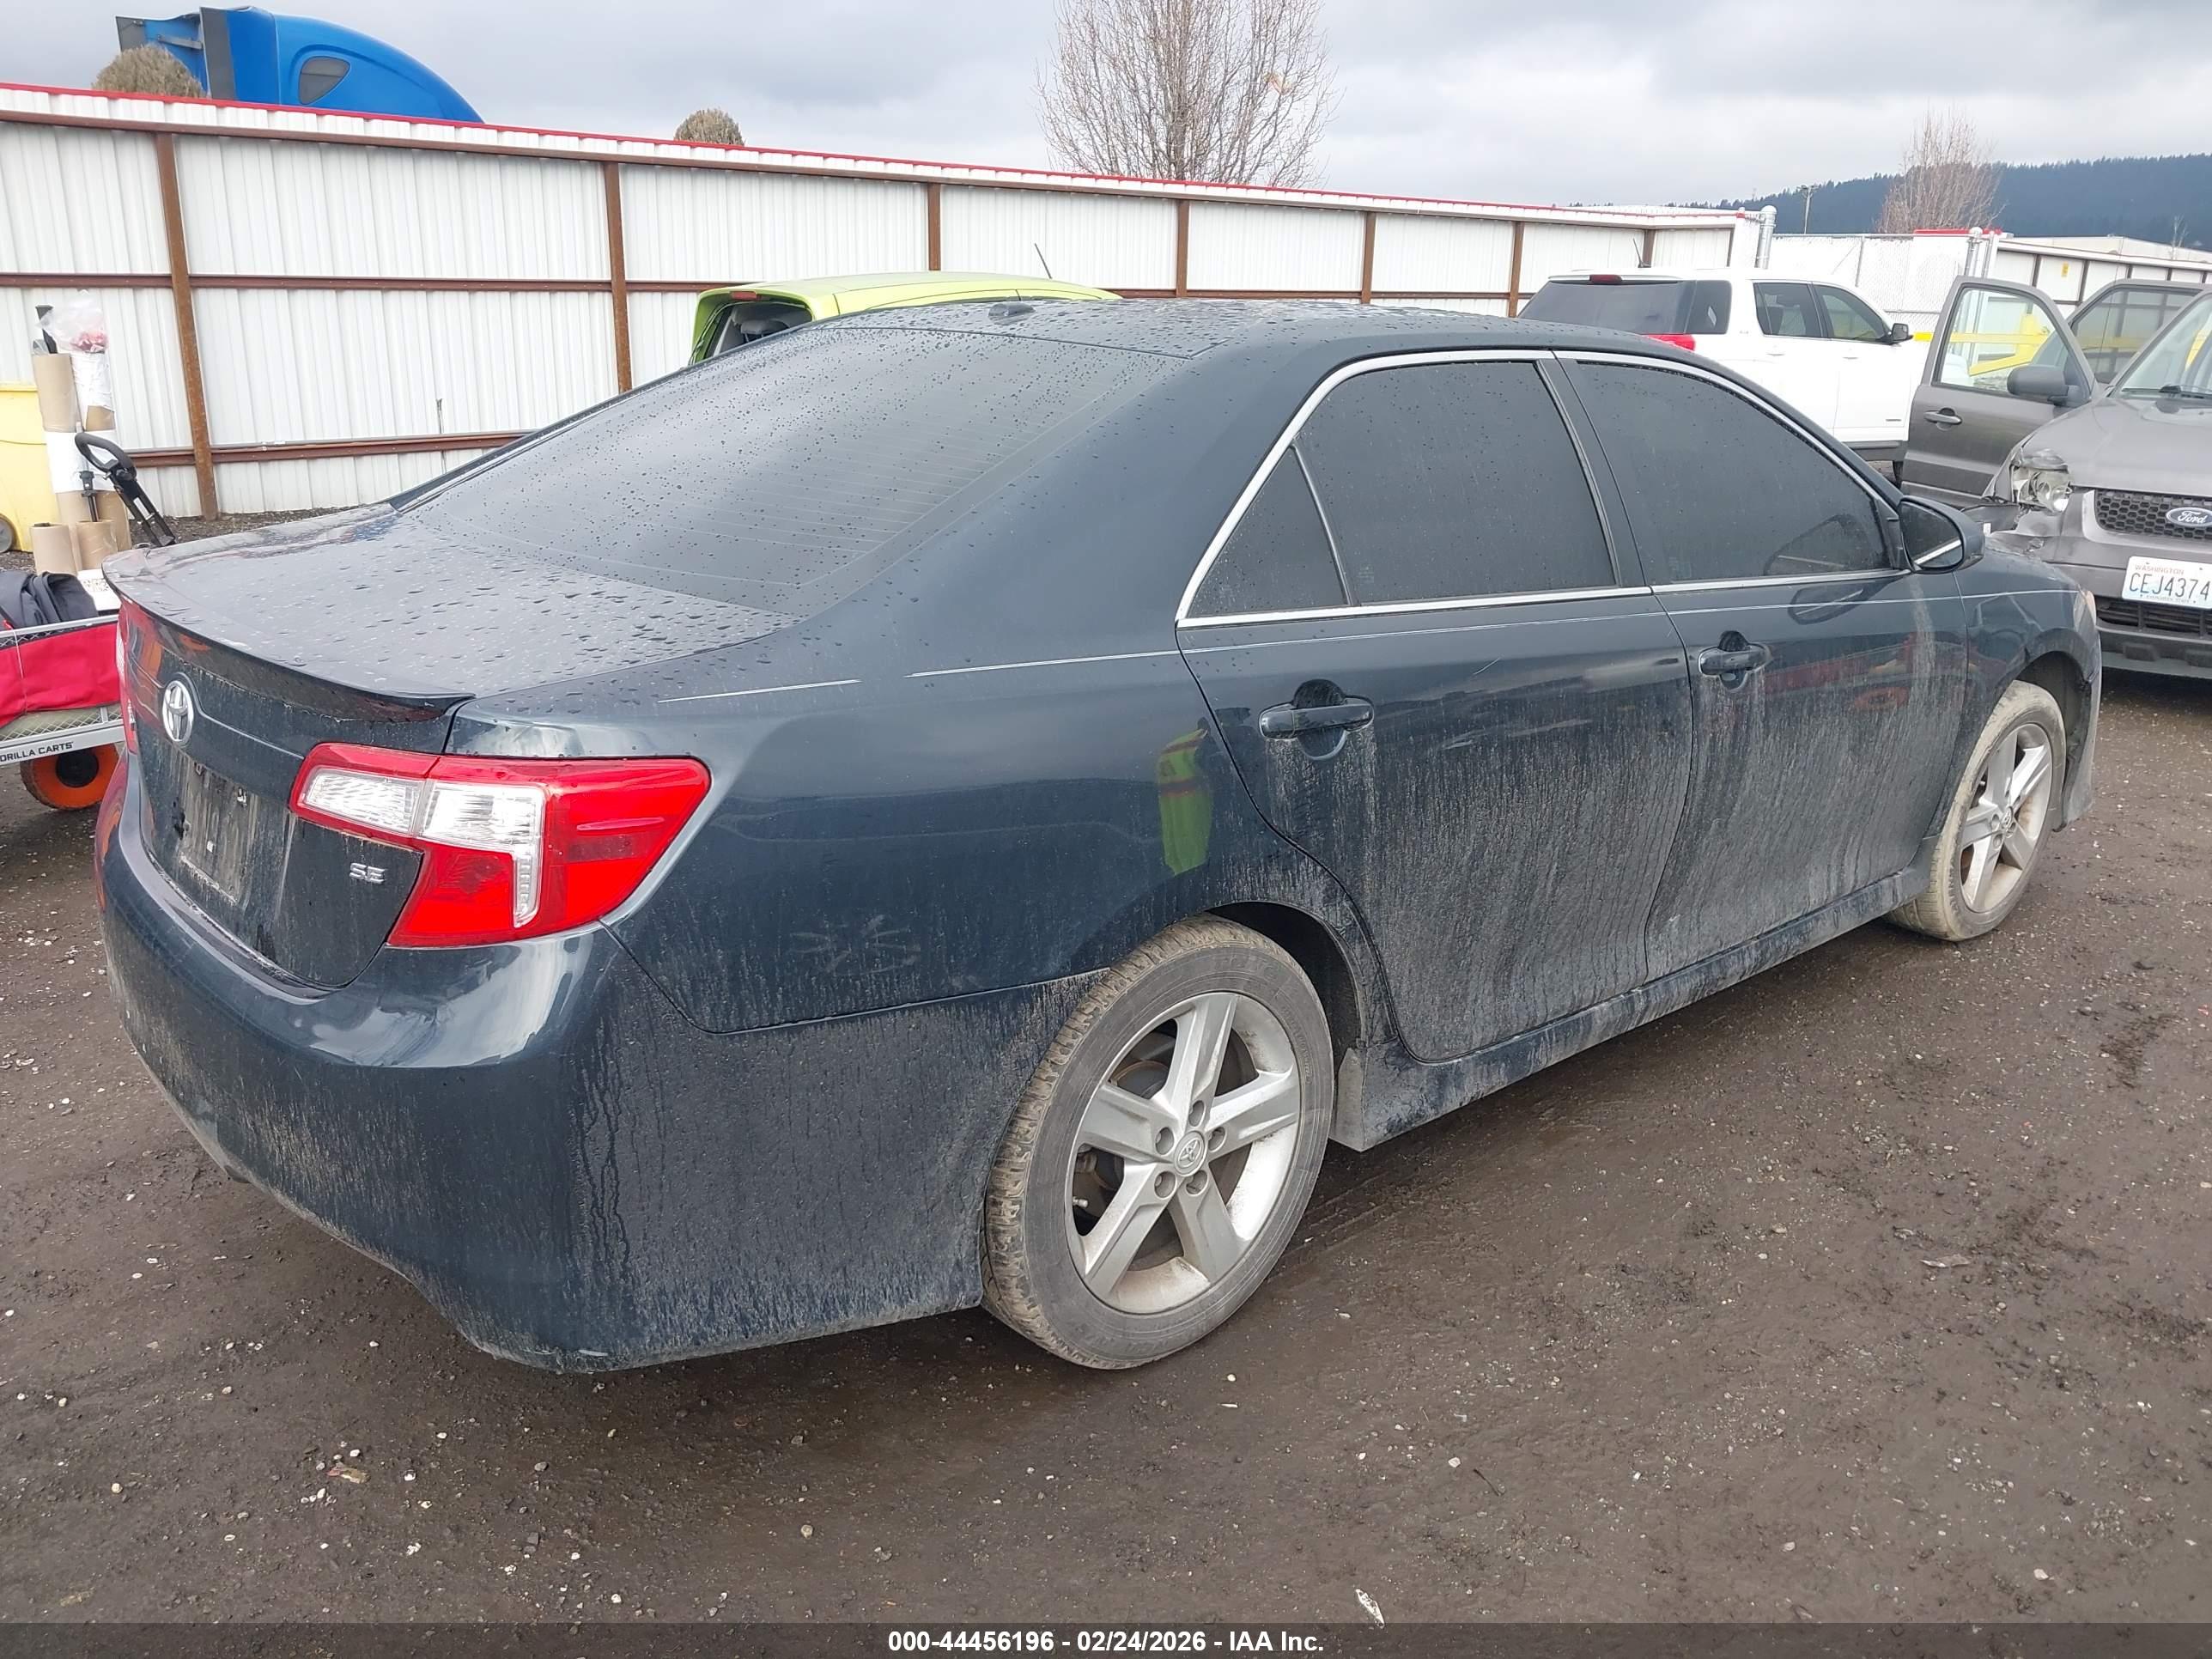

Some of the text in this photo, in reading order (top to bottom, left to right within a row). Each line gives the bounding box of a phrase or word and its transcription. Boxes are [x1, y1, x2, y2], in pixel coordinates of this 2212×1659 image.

[2177, 510, 2209, 524] Ford
[2135, 564, 2185, 575] WASHINGTON
[2129, 572, 2211, 601] CEJ4374
[38, 742, 73, 755] CARTS
[349, 862, 386, 884] SE
